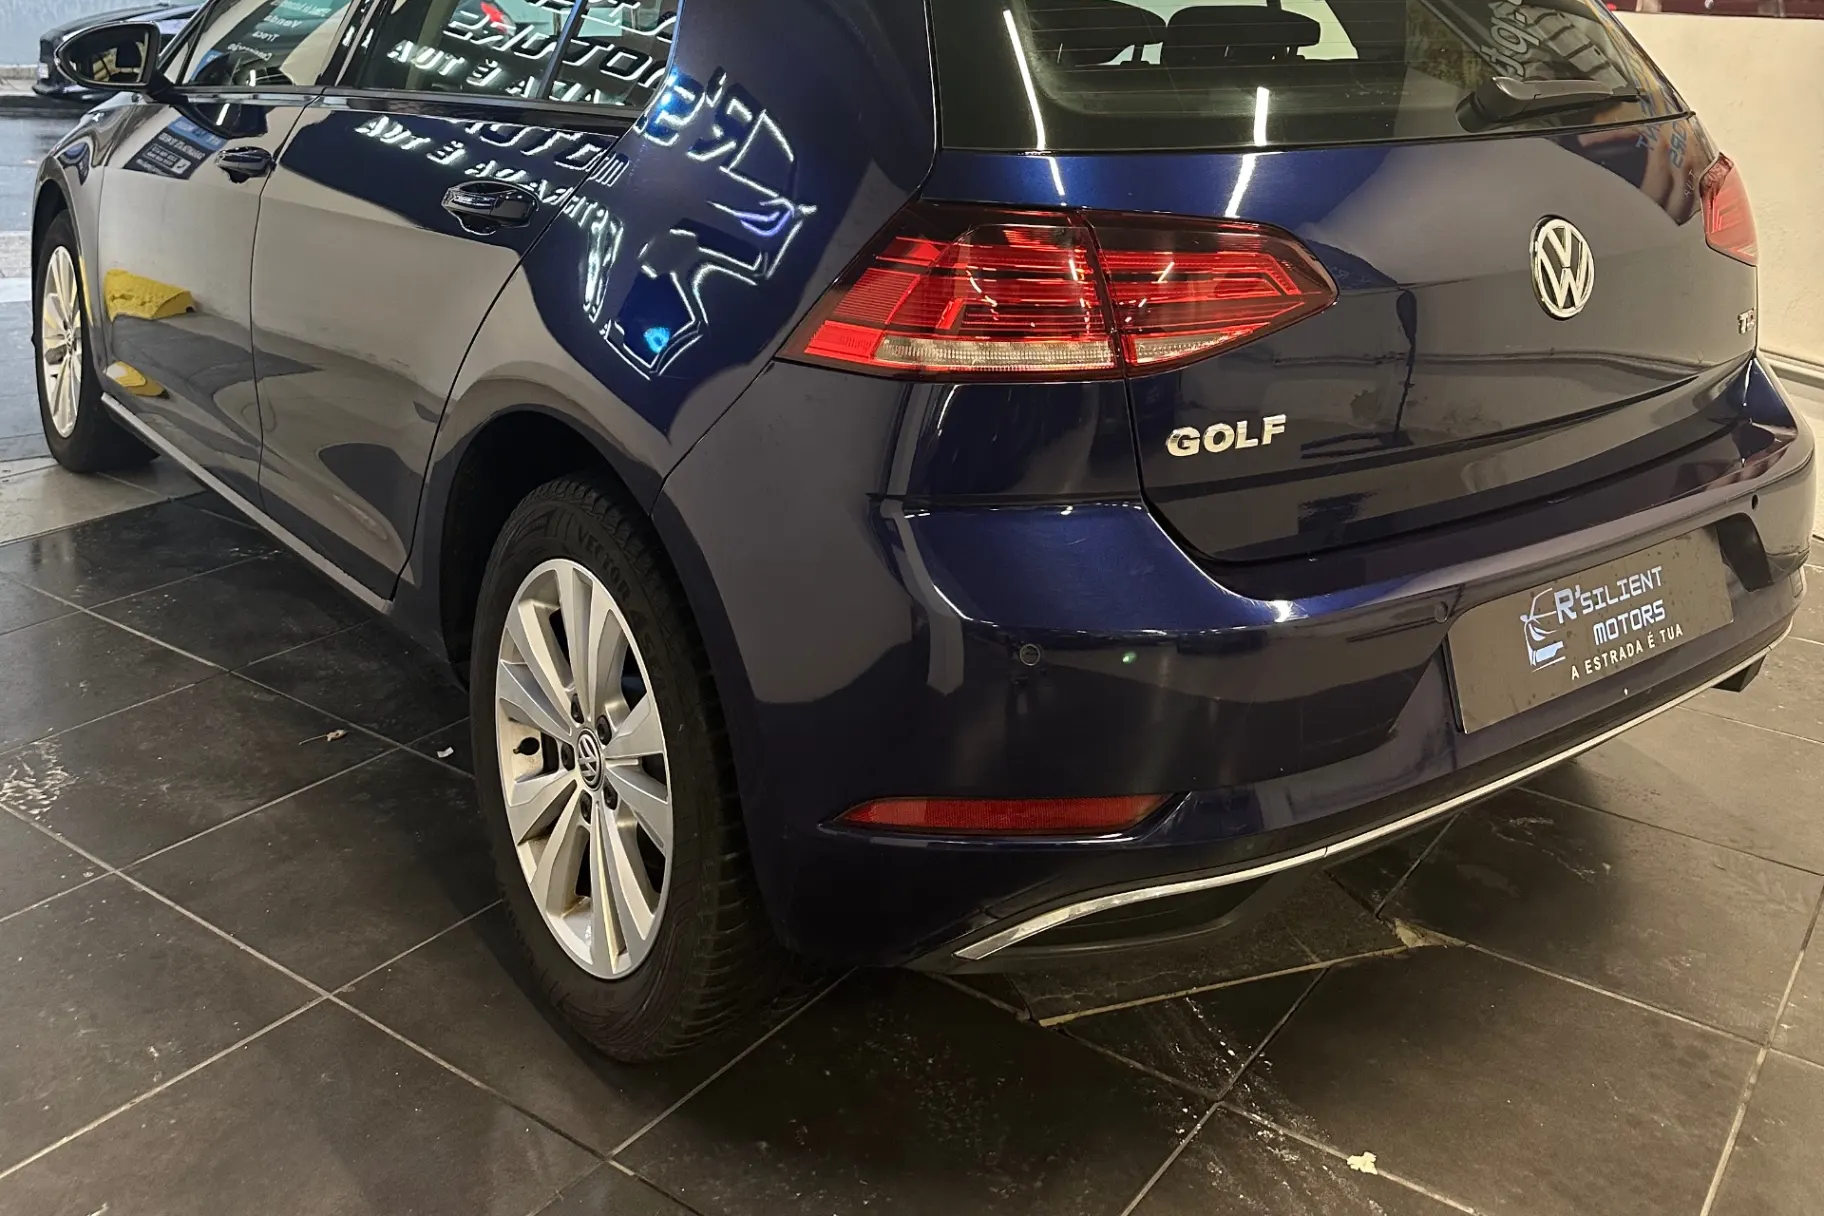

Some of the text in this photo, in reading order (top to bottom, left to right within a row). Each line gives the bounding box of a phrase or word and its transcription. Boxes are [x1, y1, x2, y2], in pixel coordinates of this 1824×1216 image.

[1165, 414, 1287, 457] GOLF
[578, 524, 632, 603] VECTOR
[1554, 565, 1664, 624] R'SILIENT
[1592, 599, 1666, 646] MOTORS
[1571, 623, 1684, 680] A ESTRADA É TUA
